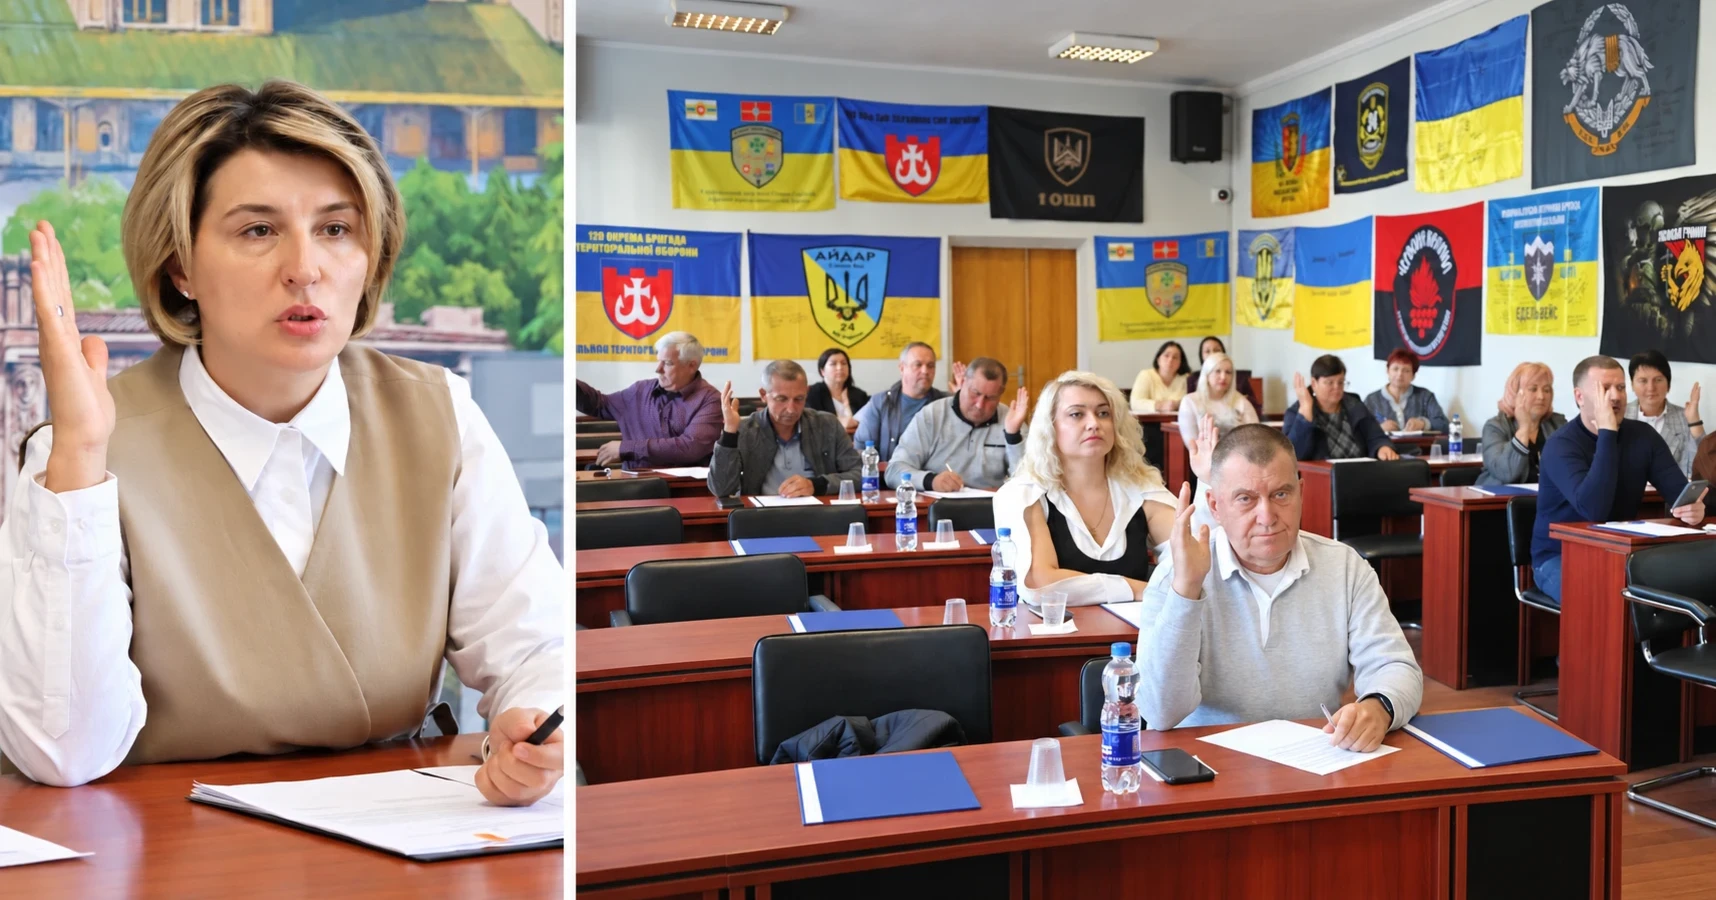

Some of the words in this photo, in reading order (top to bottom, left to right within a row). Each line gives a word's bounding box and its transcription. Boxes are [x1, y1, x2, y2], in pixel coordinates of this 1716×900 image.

[588, 231, 604, 241] 120
[606, 231, 644, 243] ОКРЕМА
[645, 233, 687, 246] БРИГАДА
[655, 246, 699, 257] ОБОРОНИ
[815, 248, 876, 262] АЙДАР
[840, 323, 855, 331] 24
